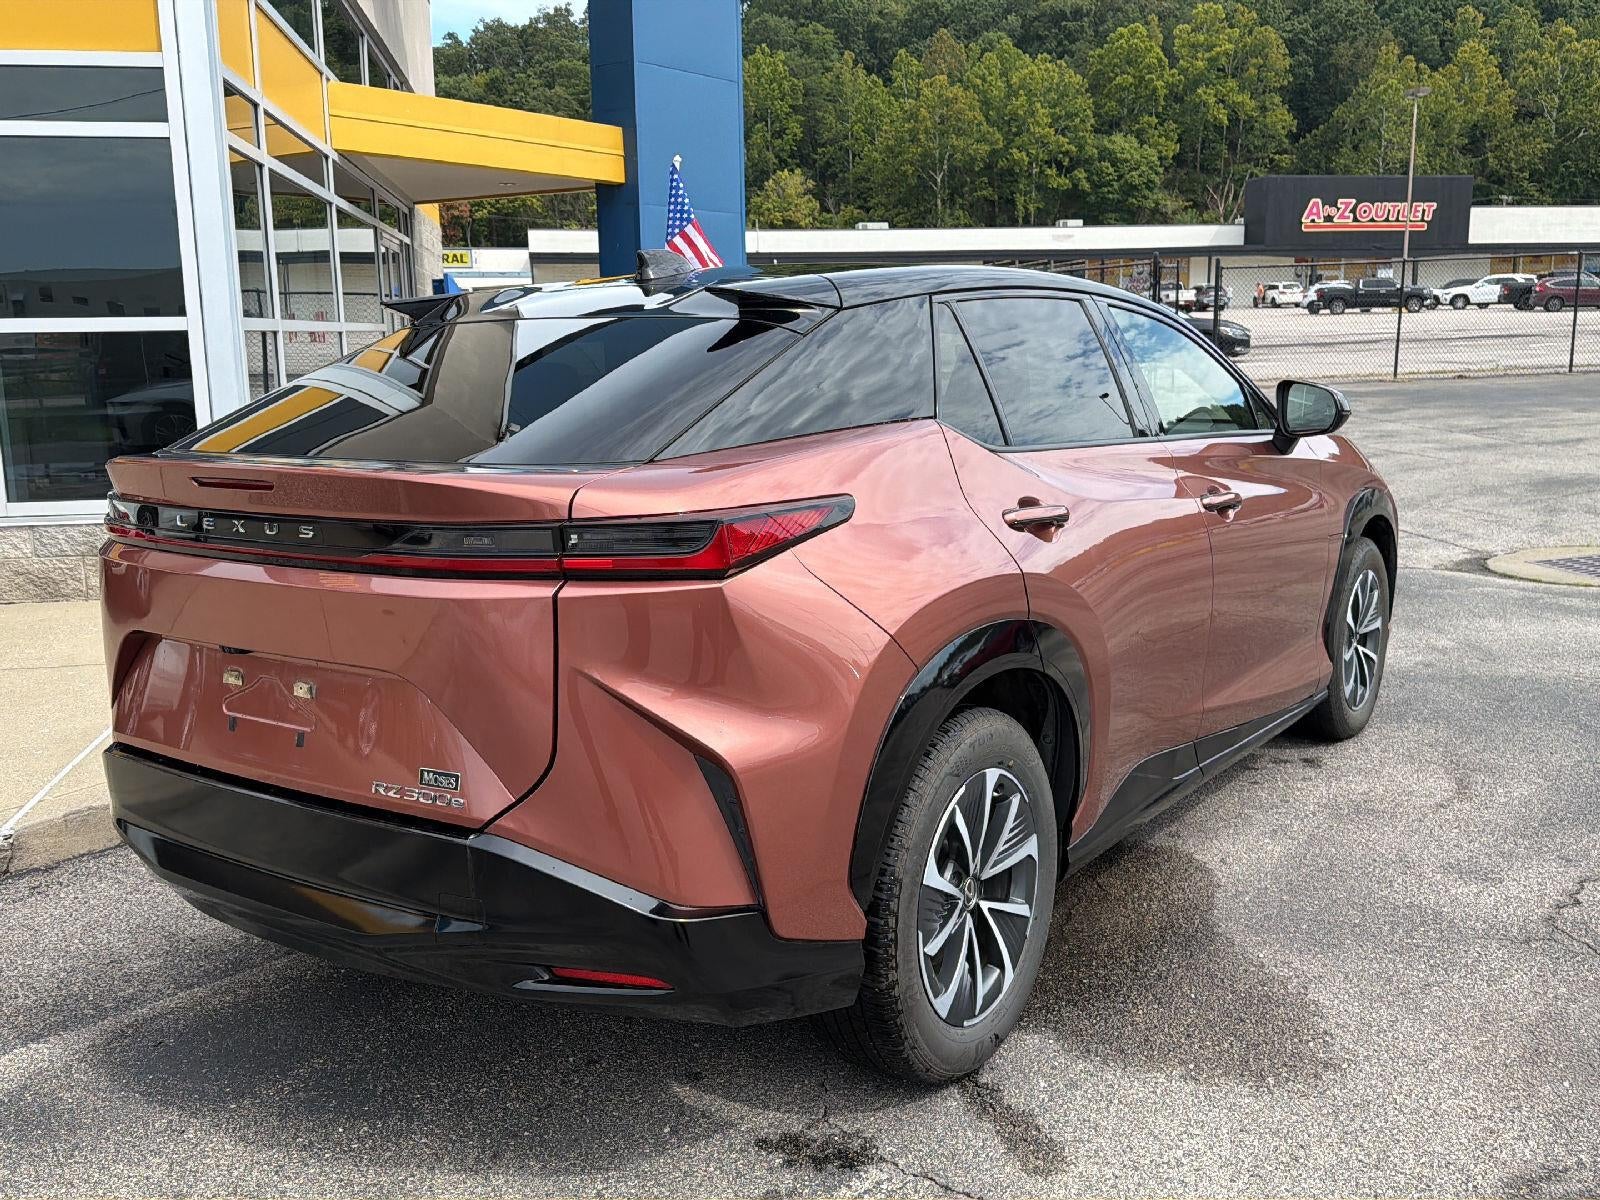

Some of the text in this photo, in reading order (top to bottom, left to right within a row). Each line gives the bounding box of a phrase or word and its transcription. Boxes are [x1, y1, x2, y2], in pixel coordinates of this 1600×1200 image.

[1356, 202, 1437, 222] OUTLET
[442, 253, 468, 264] RAL
[176, 514, 315, 539] LEXUS
